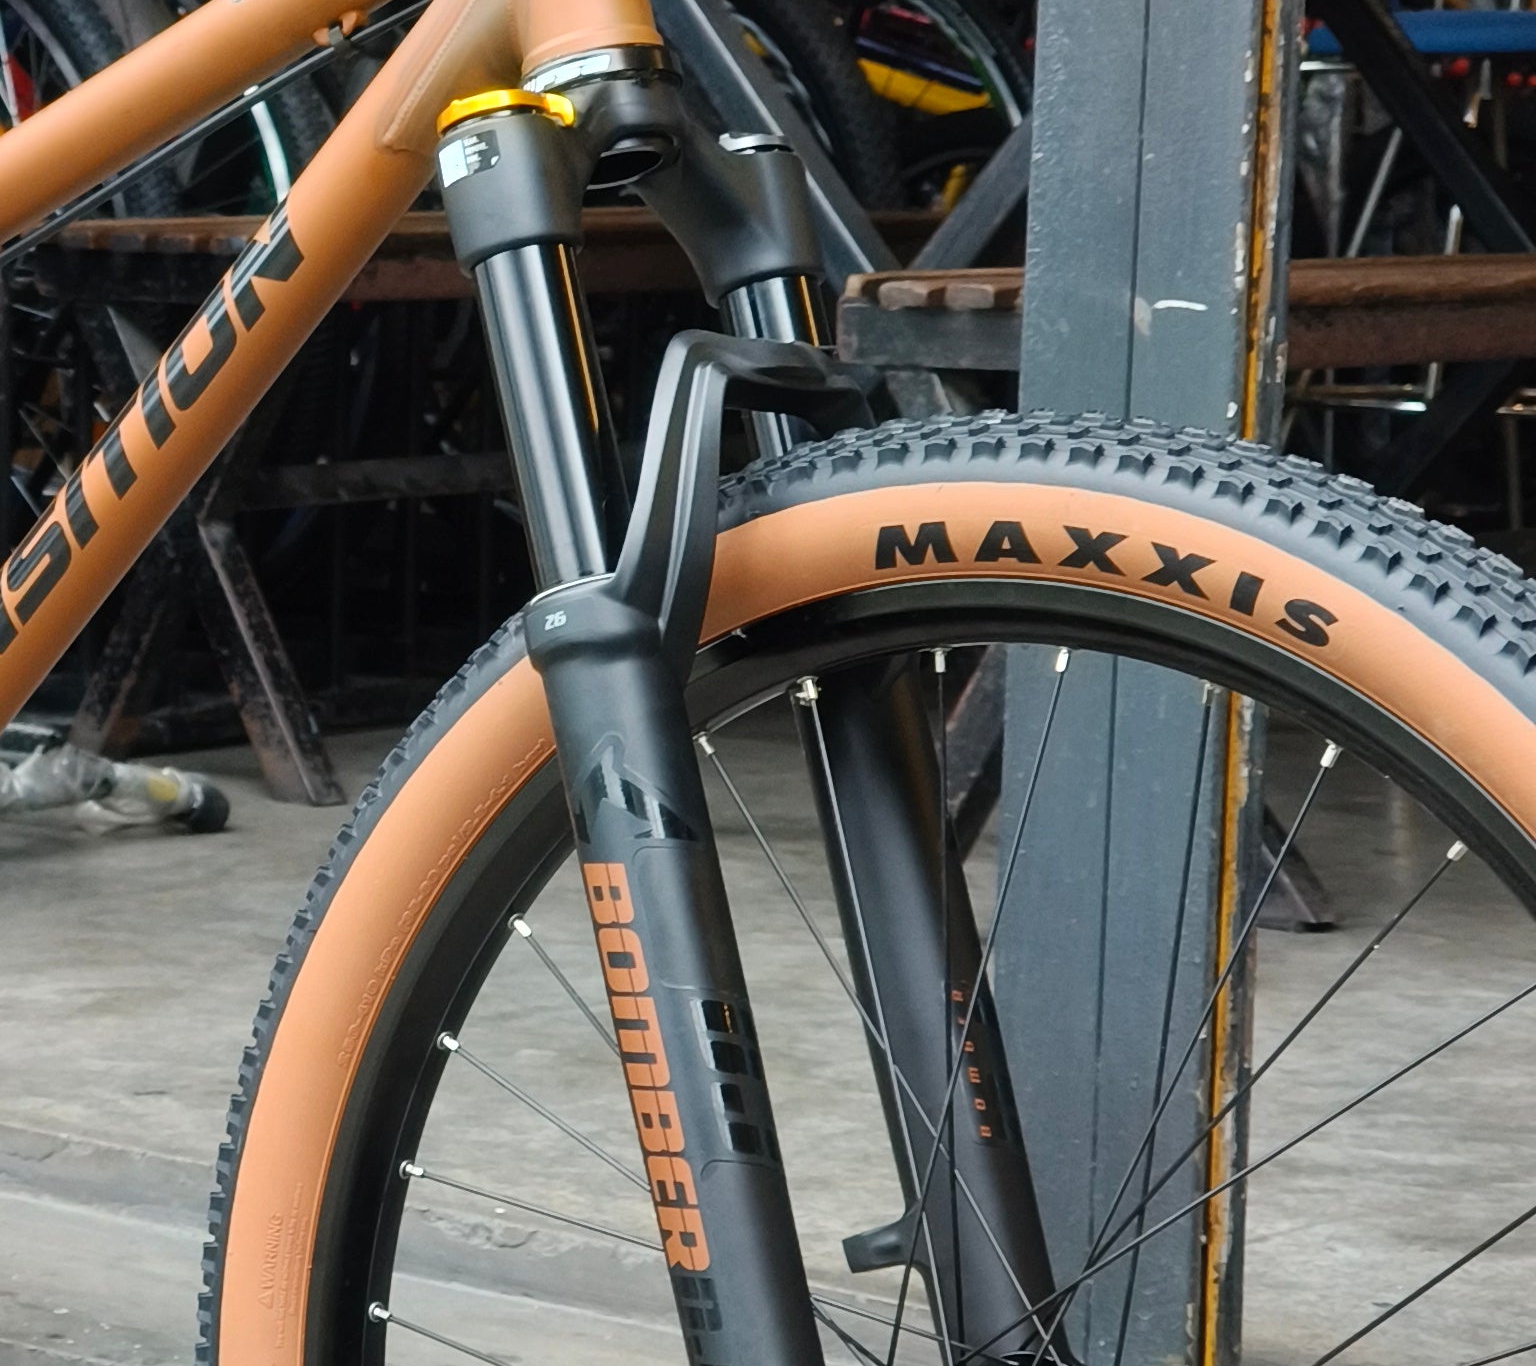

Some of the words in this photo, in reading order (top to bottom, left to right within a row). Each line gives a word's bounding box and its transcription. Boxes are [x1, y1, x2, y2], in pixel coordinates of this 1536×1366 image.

[874, 520, 1339, 648] MAXXIS
[583, 862, 711, 1272] BOMBER
[260, 1210, 283, 1290] WARNING
